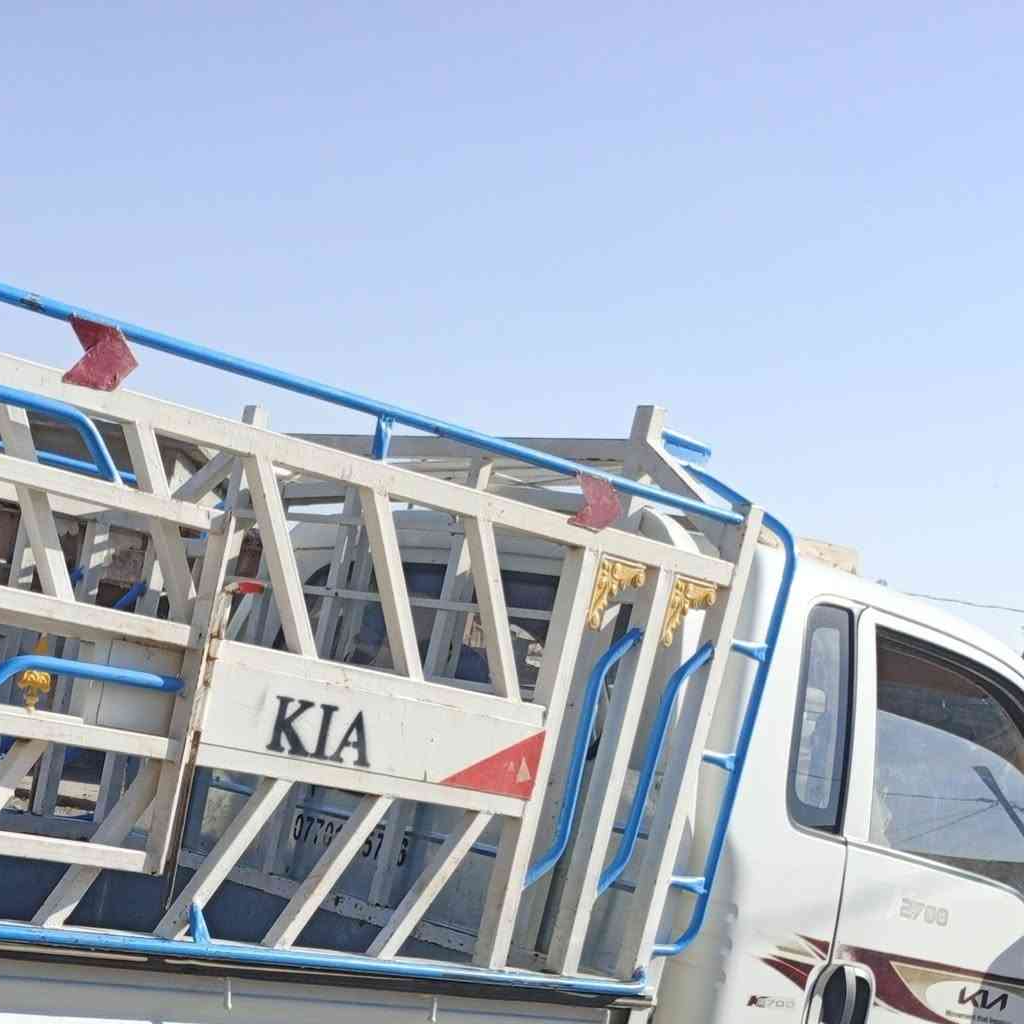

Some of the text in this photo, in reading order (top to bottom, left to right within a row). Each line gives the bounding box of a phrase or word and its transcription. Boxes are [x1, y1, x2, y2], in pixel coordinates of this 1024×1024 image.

[266, 695, 371, 768] KIA
[899, 897, 949, 927] 2700
[958, 986, 1009, 1011] KIA
